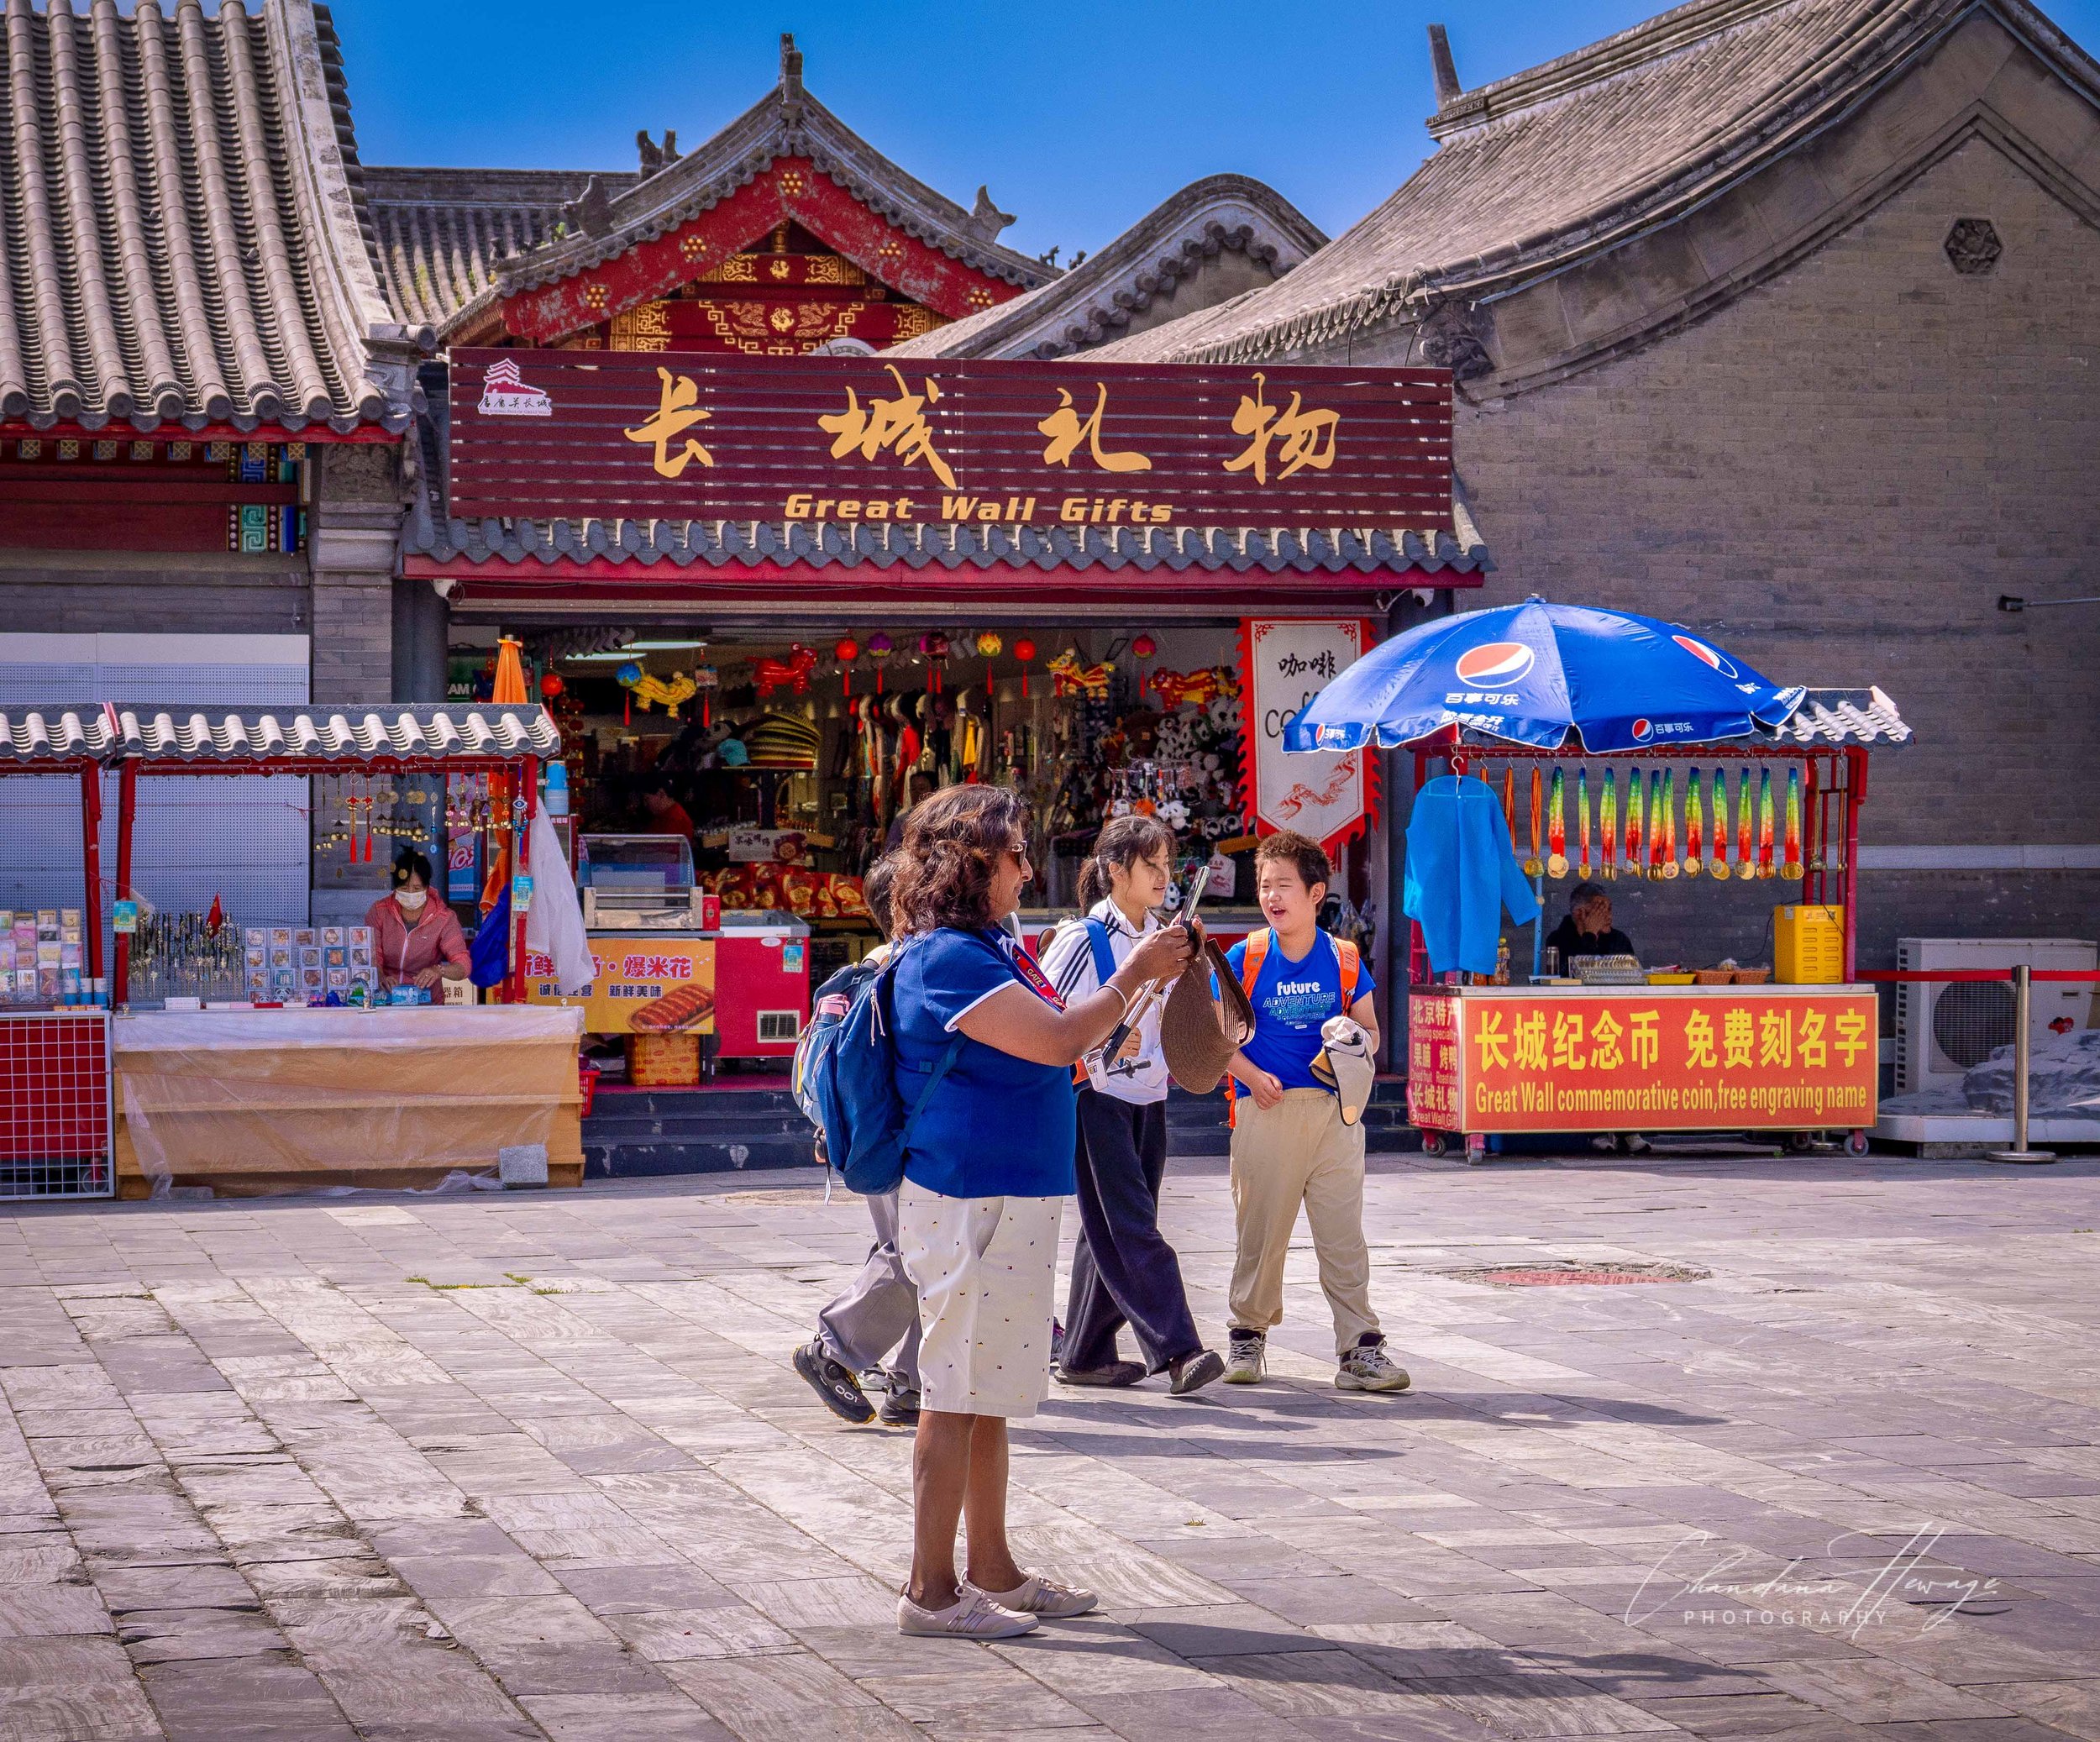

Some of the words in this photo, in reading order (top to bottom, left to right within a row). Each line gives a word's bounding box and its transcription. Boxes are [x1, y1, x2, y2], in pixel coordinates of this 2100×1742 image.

[624, 363, 1341, 491] 长城礼物
[785, 493, 915, 520] Great
[942, 495, 1035, 522] Wall
[1060, 497, 1173, 524] Gifts
[1278, 649, 1337, 679] 咖啡
[447, 683, 470, 695] AM
[1444, 692, 1520, 706] 百事可乐
[1654, 721, 1694, 735] 百事可乐
[608, 984, 663, 999] 新鲜美味
[1276, 981, 1320, 996] future
[1263, 992, 1336, 1008] ADVENTURE
[1413, 999, 1457, 1026] 北京特产
[1474, 1009, 1661, 1073] 长城纪念币
[1683, 1007, 1867, 1070] 免费刻名字
[1413, 1083, 1457, 1112] 长城礼物
[1475, 1081, 1518, 1114] Great
[1520, 1081, 1554, 1113] Wall
[1557, 1079, 1679, 1112] commemorative
[1751, 1078, 1823, 1116] engraving
[1827, 1084, 1866, 1110] name
[1410, 1109, 1431, 1124] Great
[835, 1384, 858, 1404] 001
